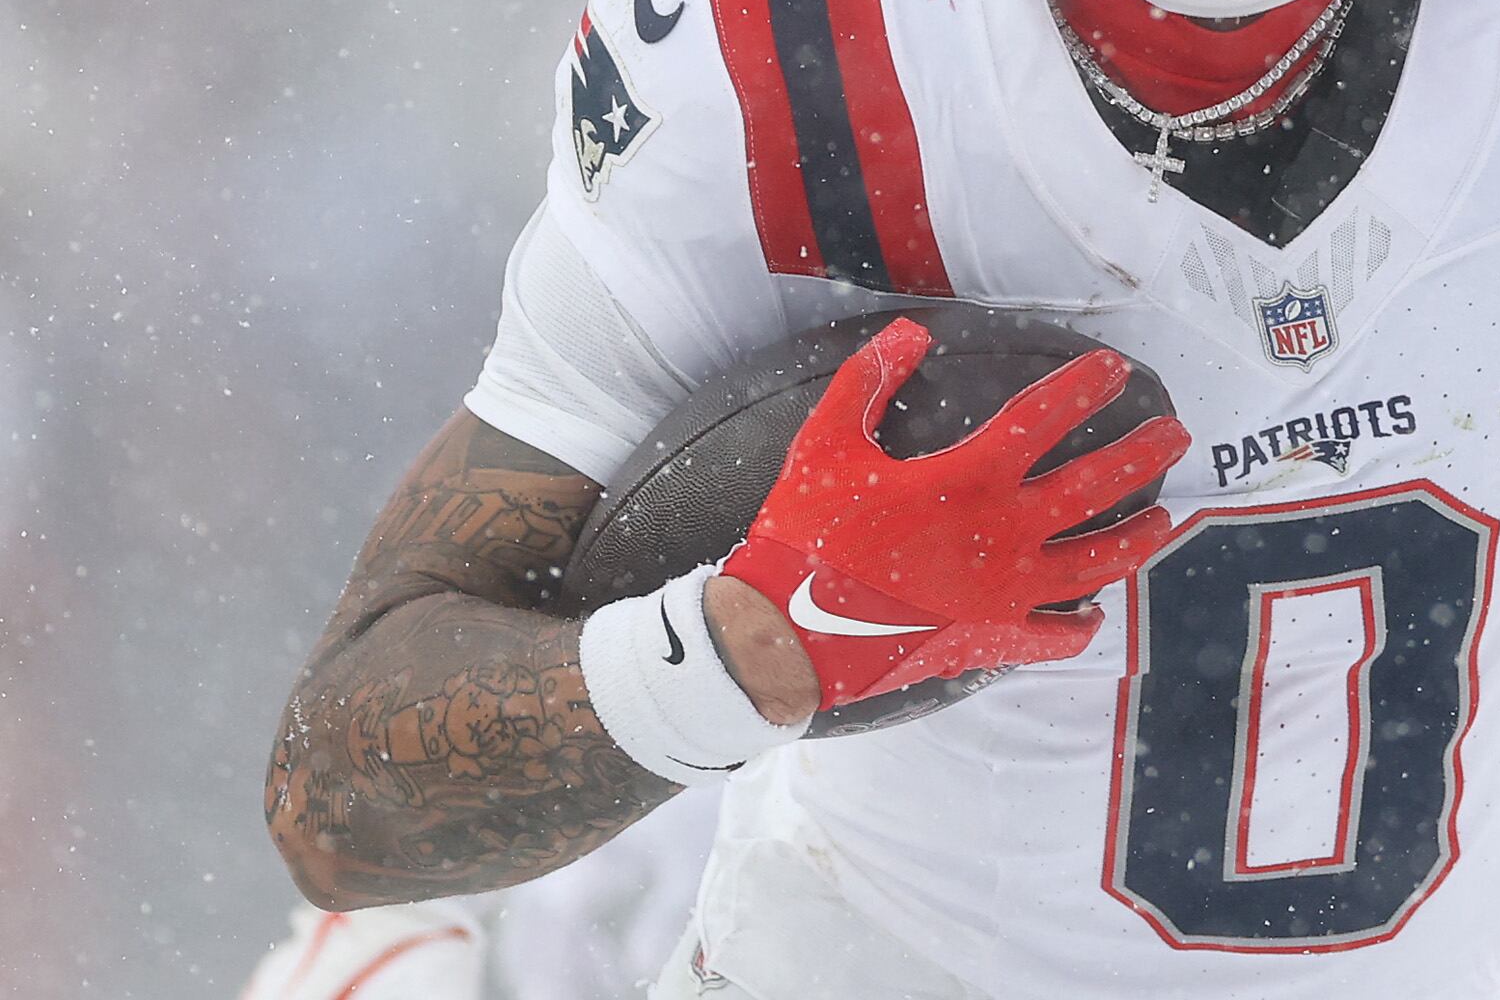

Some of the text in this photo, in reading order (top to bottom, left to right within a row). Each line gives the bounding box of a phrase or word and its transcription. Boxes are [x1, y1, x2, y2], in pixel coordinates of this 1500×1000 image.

[1271, 320, 1328, 356] NFL
[1211, 394, 1416, 488] PATRIOTS
[1101, 478, 1500, 955] 0
